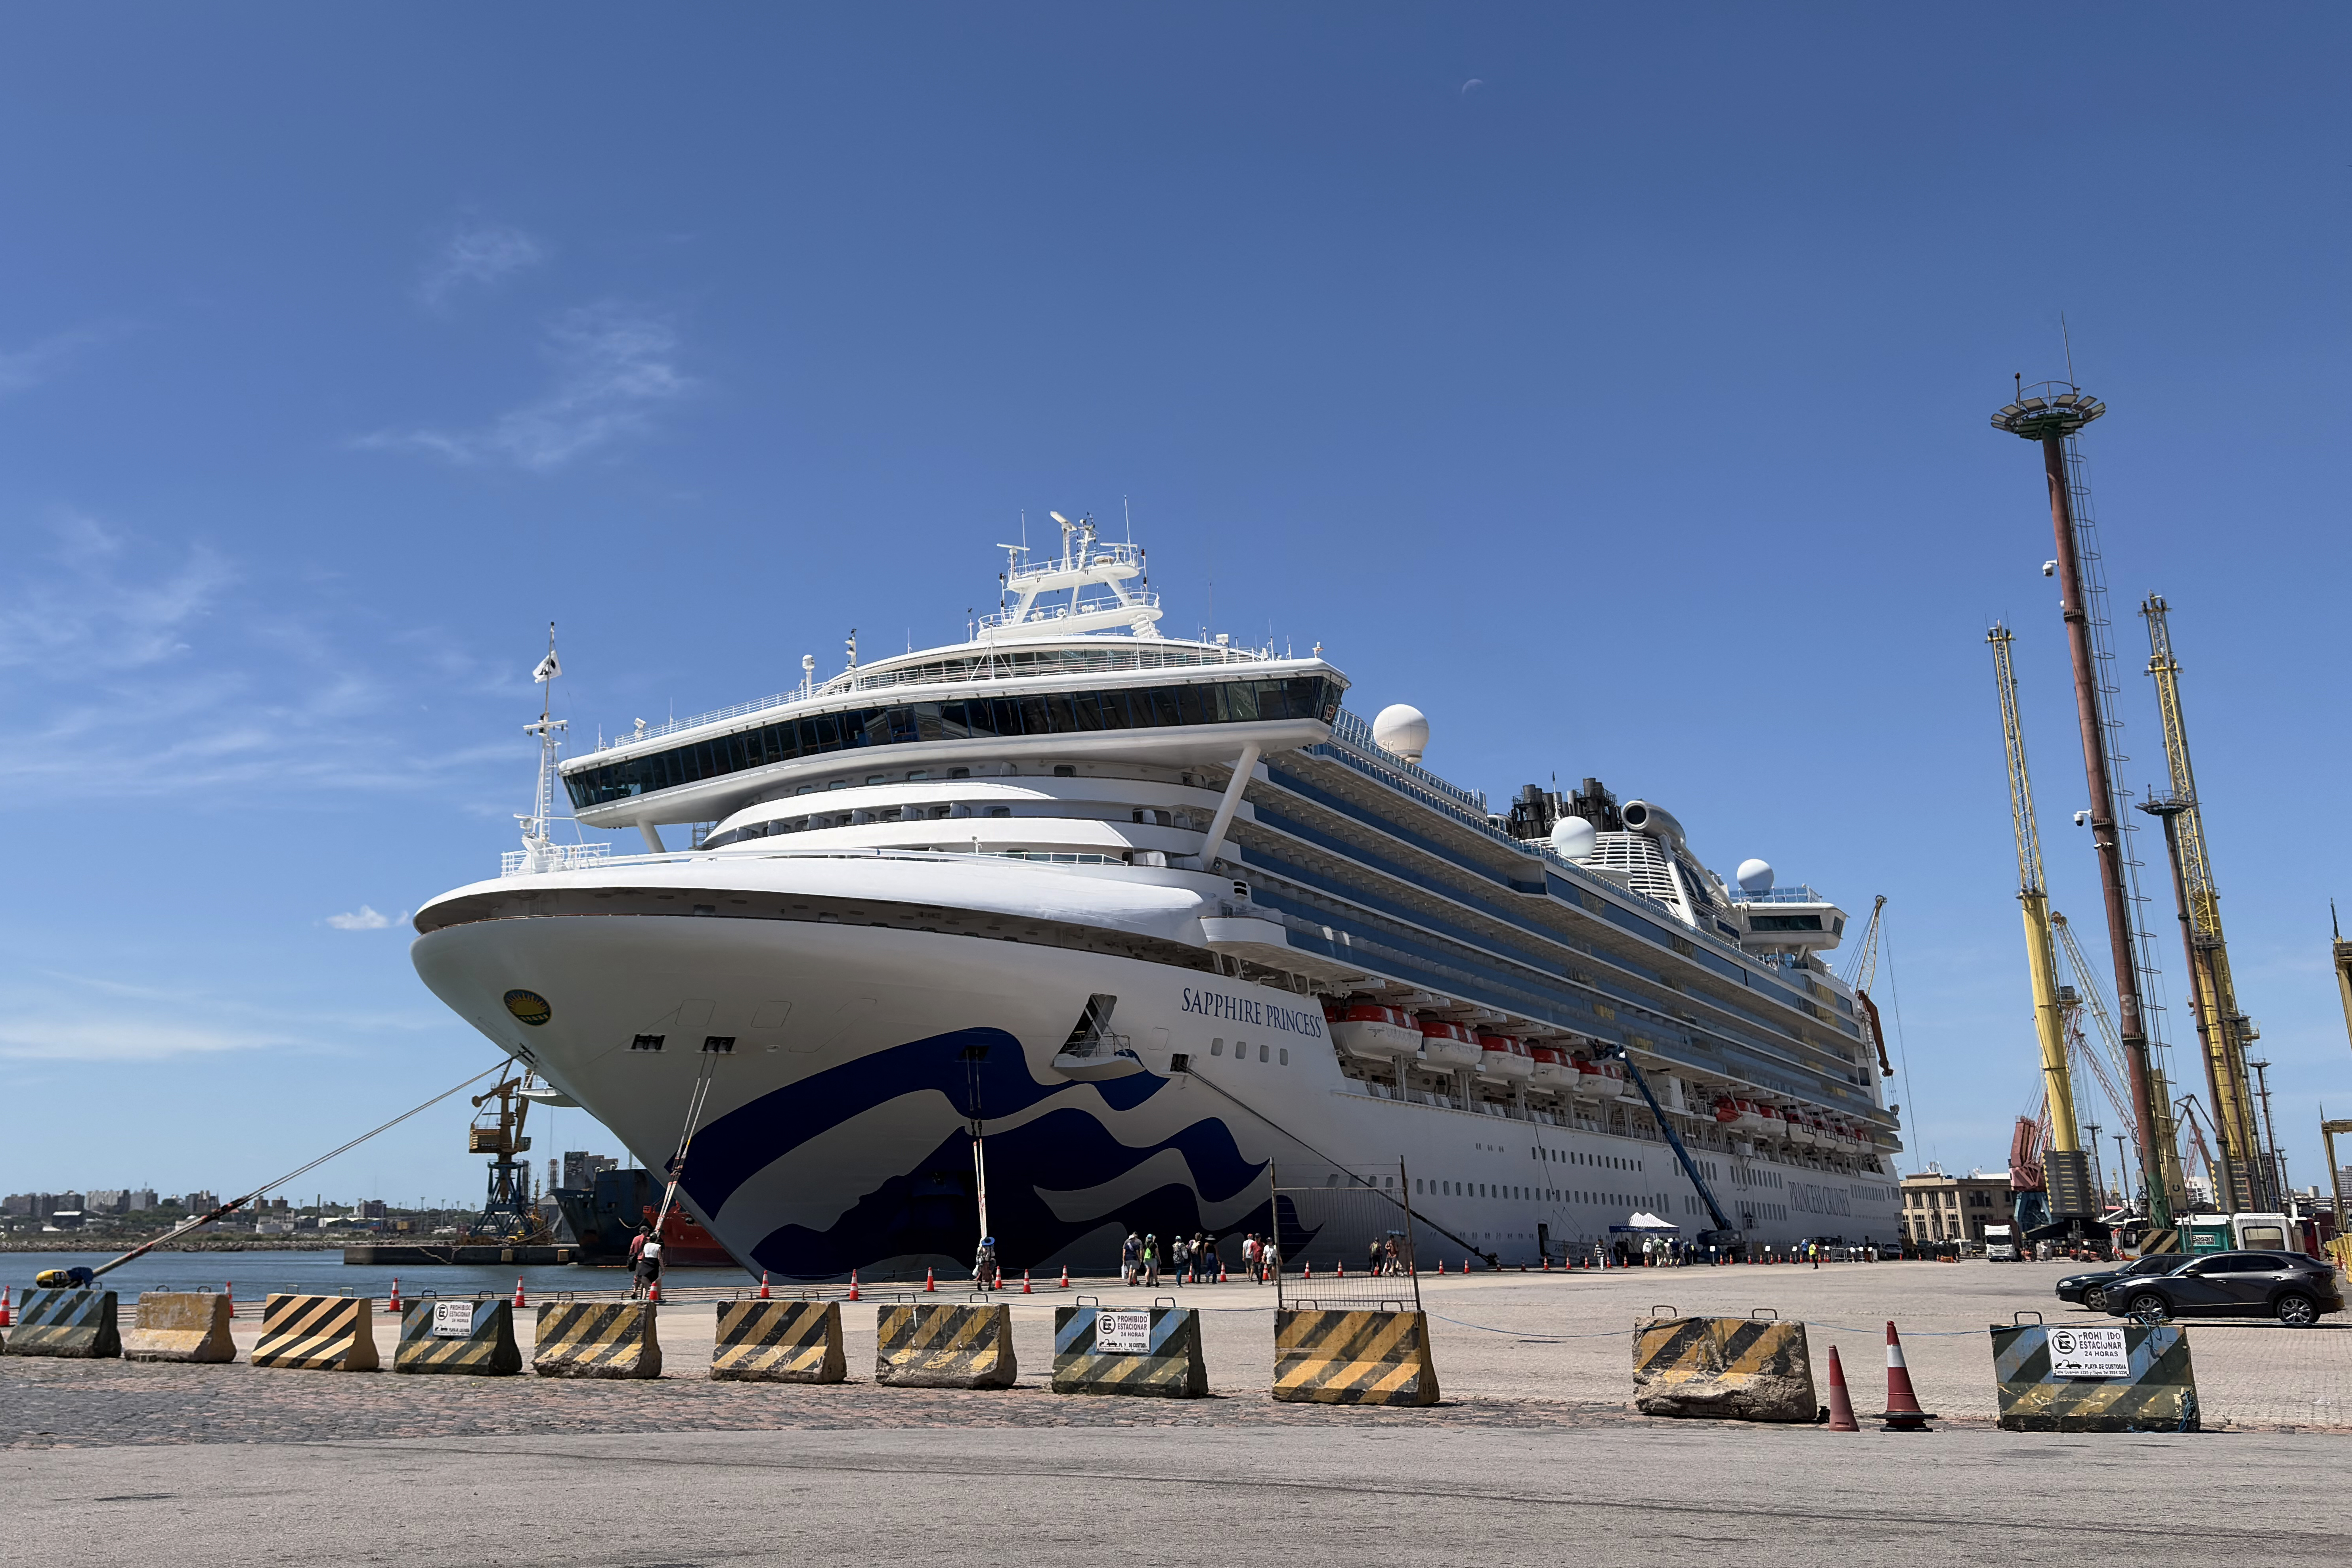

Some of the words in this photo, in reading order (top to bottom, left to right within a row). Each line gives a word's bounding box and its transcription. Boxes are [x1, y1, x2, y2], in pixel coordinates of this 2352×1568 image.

[1182, 987, 1262, 1025] SAPPHIRE
[1266, 1004, 1321, 1038] PRINCESS
[2120, 994, 2137, 1016] 3
[1788, 1181, 1823, 1214] PRINCESS
[1823, 1186, 1851, 1217] CRUISES
[2078, 1332, 2121, 1340] PROHIIDO
[2079, 1341, 2122, 1350] ESTACIONAR
